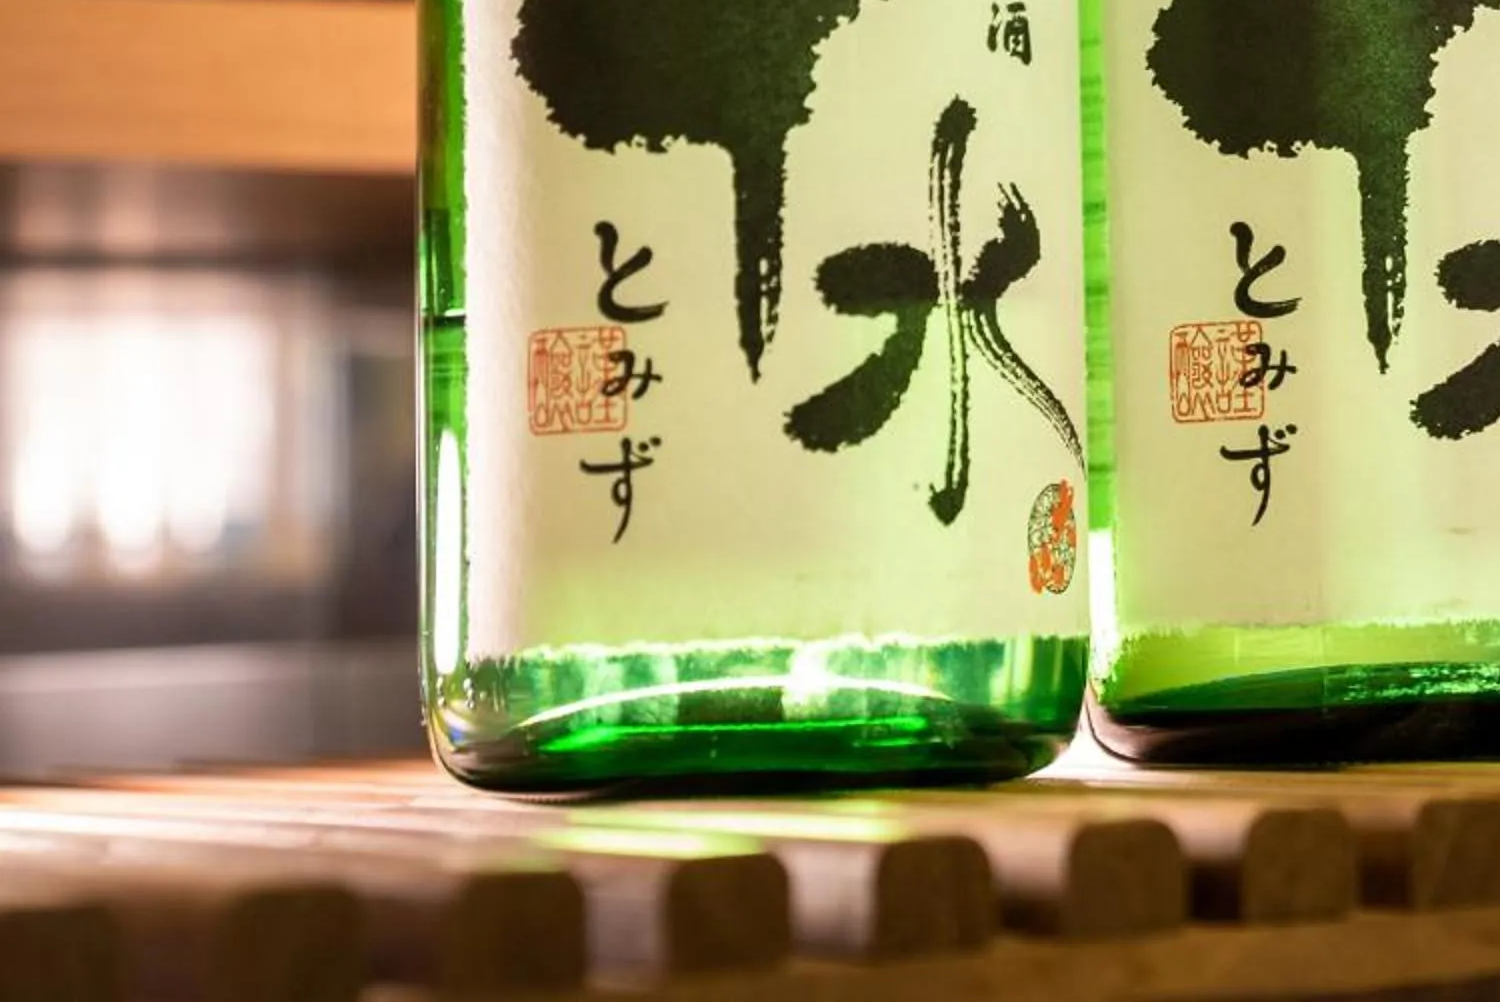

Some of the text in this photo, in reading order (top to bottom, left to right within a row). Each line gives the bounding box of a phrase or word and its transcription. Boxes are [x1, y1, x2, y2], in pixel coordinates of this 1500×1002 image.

[579, 220, 670, 544] とみず
[1219, 220, 1303, 527] とみず
